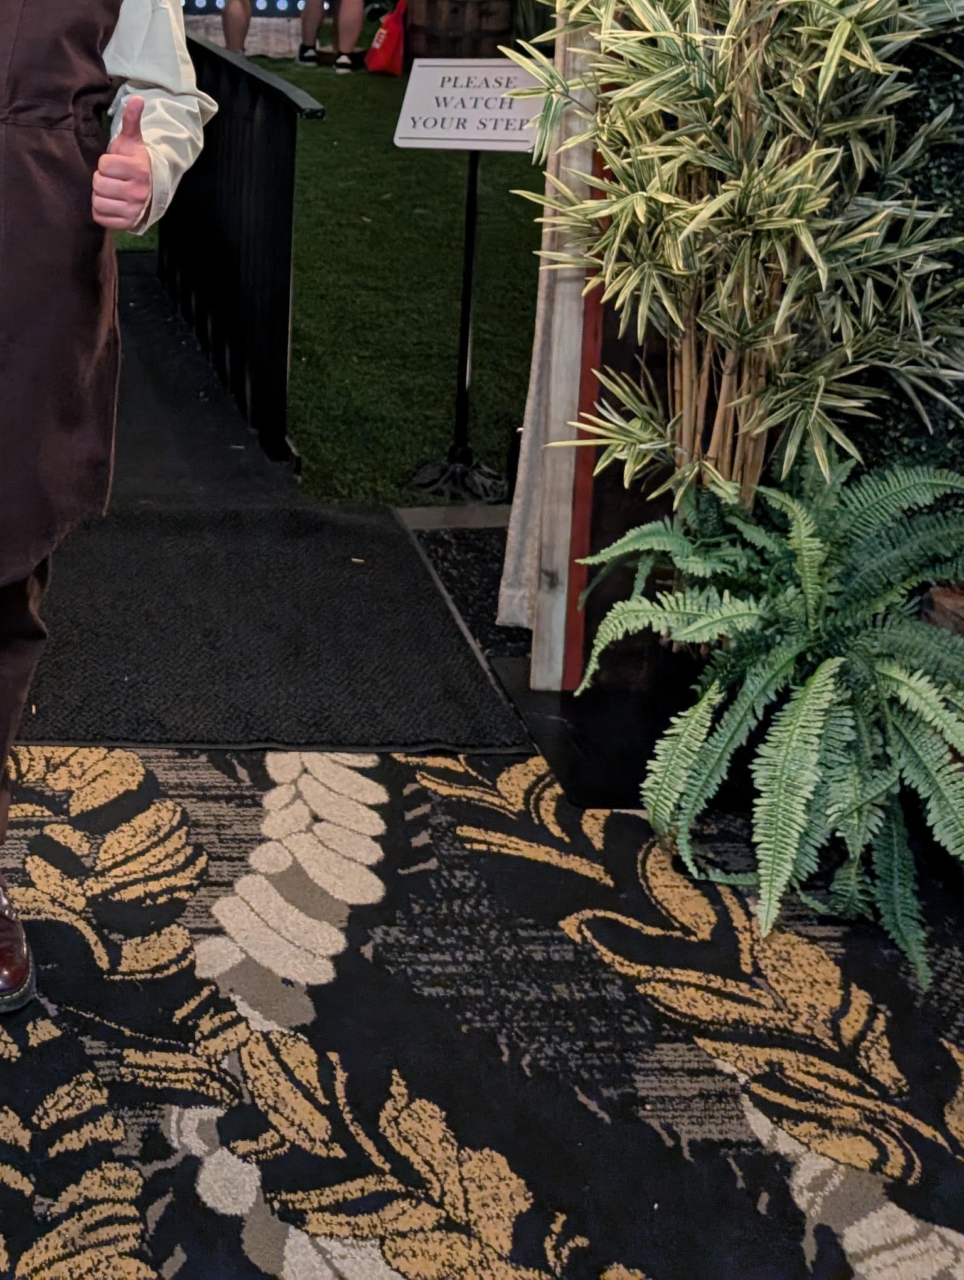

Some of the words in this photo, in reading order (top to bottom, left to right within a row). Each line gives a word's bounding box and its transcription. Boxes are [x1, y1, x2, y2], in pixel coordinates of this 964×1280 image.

[439, 76, 519, 89] PLEASE
[434, 96, 515, 110] WATCH
[410, 116, 468, 130] YOUR
[476, 118, 530, 131] STEP
